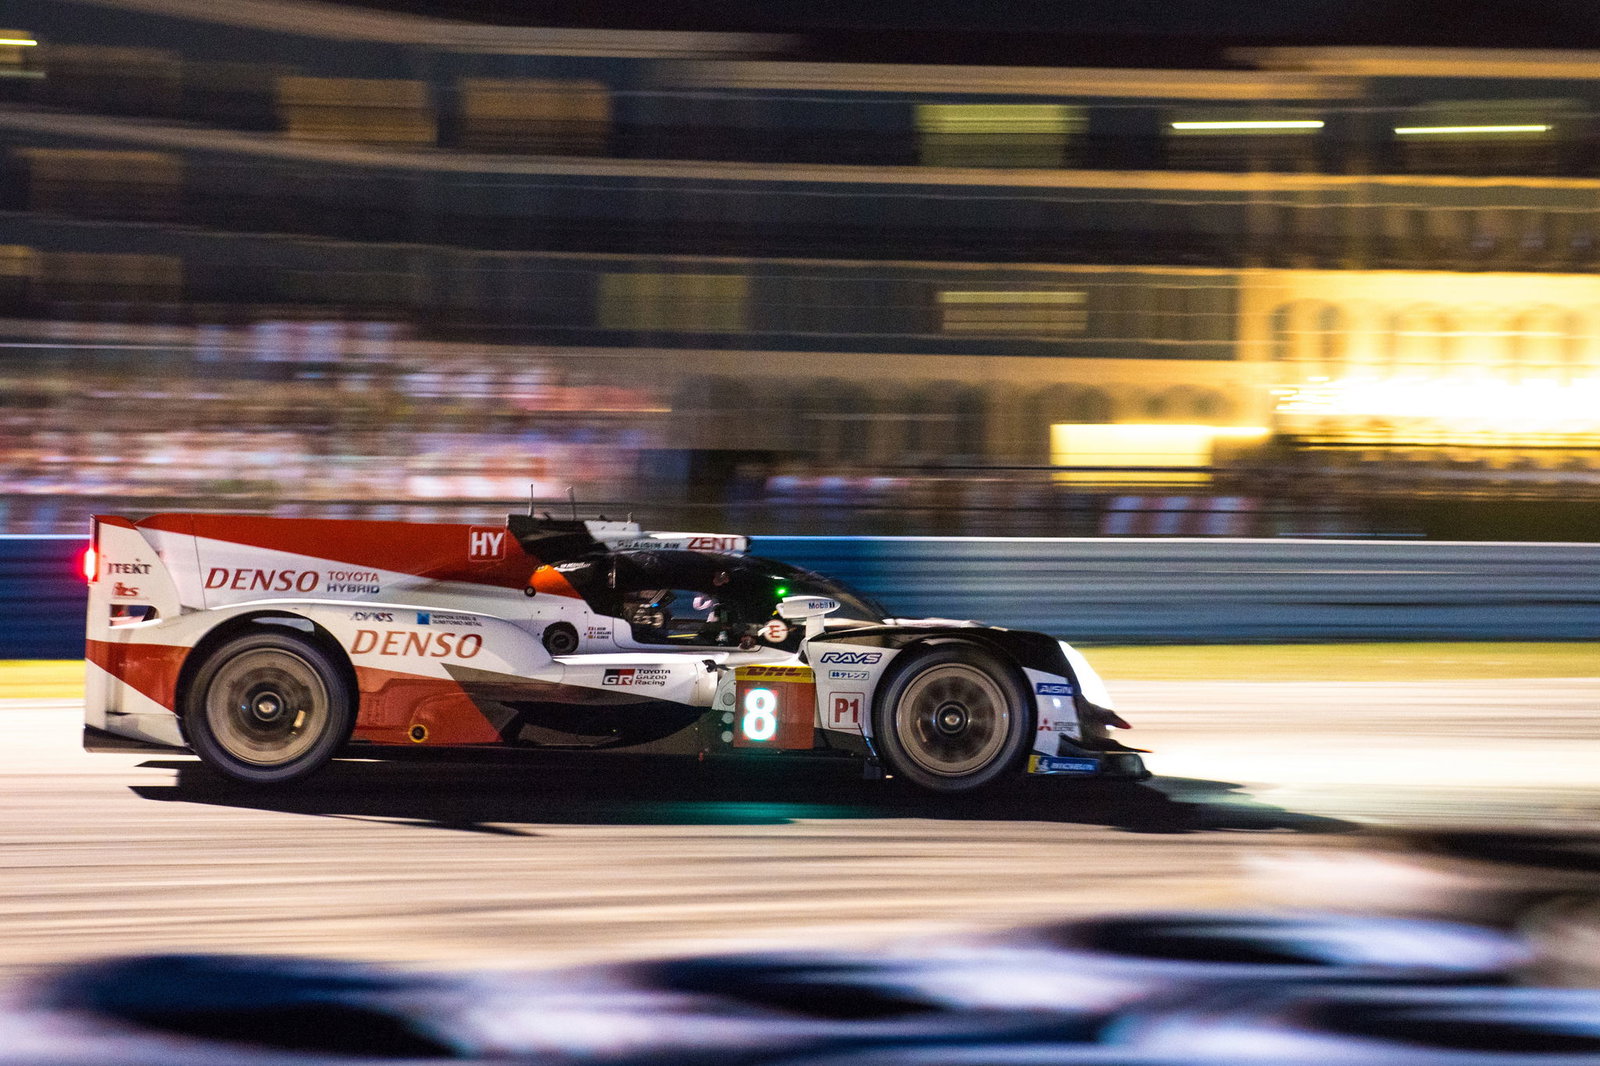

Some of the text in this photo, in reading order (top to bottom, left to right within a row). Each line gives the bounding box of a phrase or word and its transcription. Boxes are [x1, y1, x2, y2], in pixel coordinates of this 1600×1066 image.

[471, 531, 504, 556] HY
[687, 537, 737, 550] ZENT
[107, 563, 152, 575] JTEKT
[205, 567, 320, 593] DENSO
[327, 571, 380, 582] TOYOTA
[326, 584, 381, 594] HYBRID
[349, 629, 484, 659] DENSO
[819, 651, 883, 665] RAYS
[745, 666, 802, 677] DHL
[602, 674, 634, 686] GR
[742, 687, 777, 742] 8
[834, 698, 859, 723] P1
